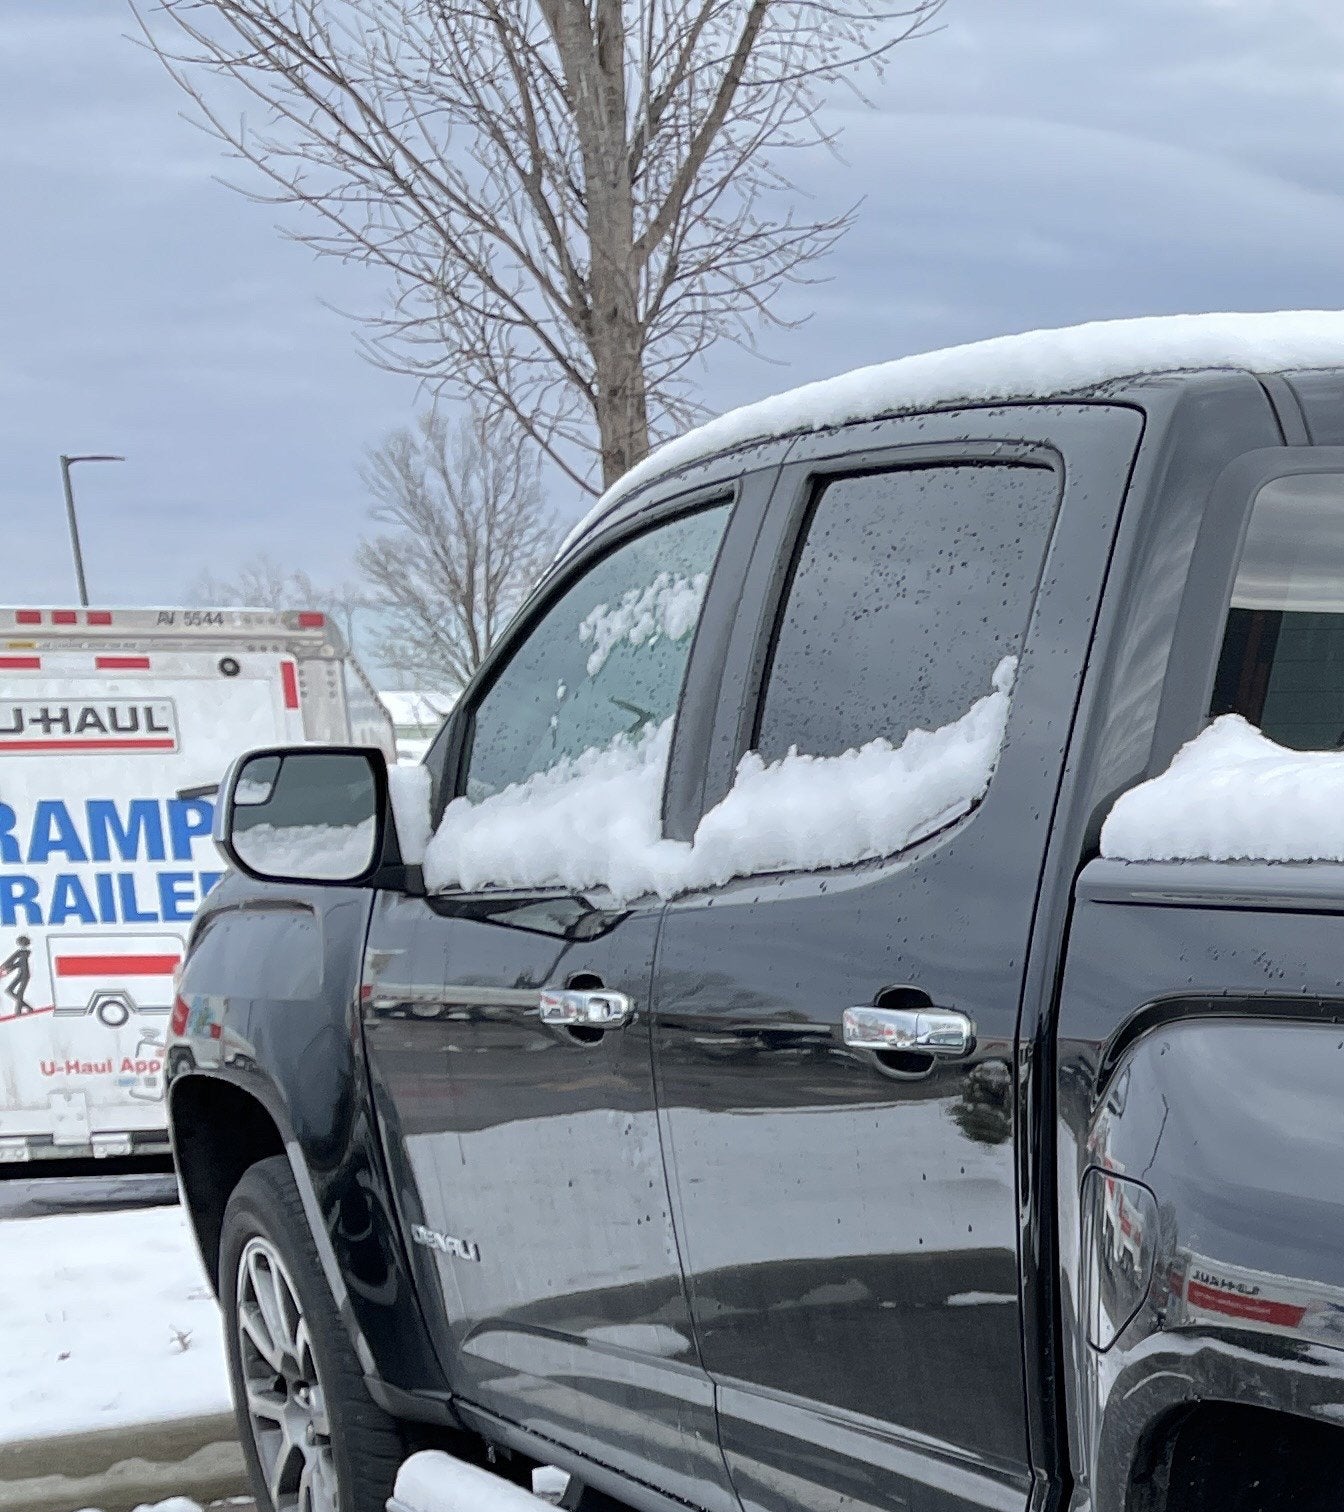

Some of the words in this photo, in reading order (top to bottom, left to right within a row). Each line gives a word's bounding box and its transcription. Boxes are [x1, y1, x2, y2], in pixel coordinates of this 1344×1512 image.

[184, 611, 225, 626] 5544
[0, 872, 223, 925] RAILE
[40, 1059, 113, 1076] U-Haul
[120, 1056, 161, 1075] App
